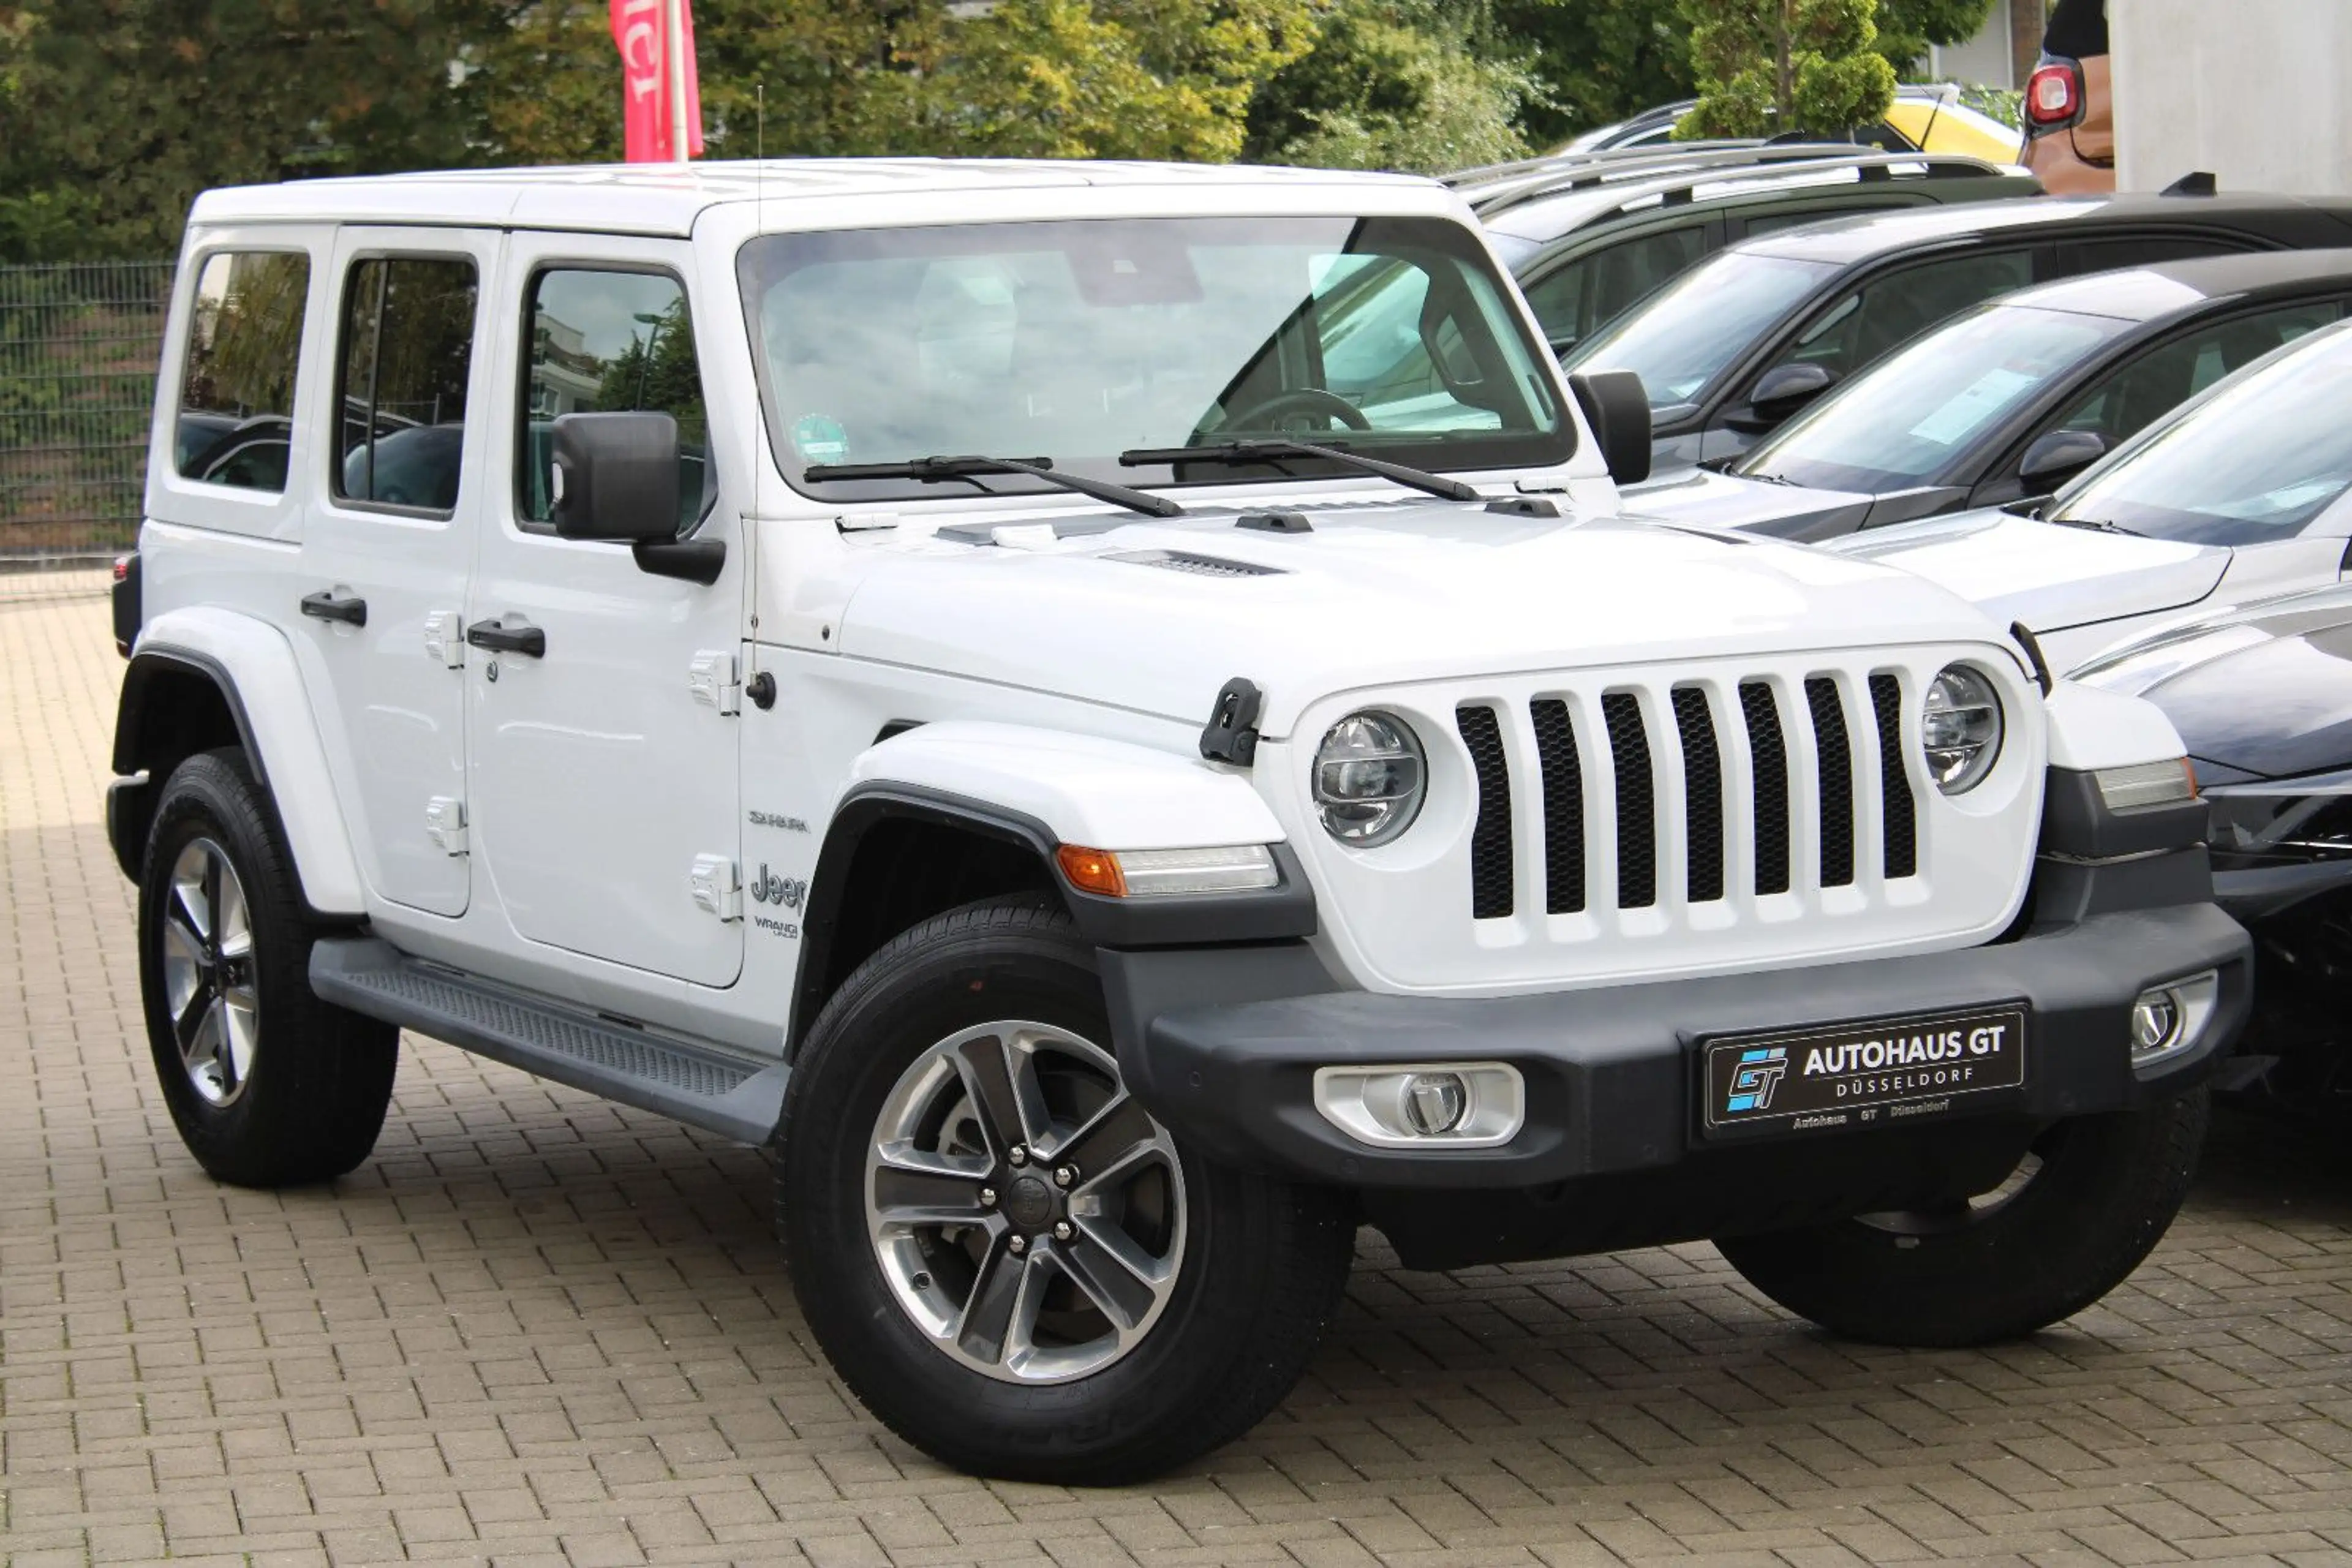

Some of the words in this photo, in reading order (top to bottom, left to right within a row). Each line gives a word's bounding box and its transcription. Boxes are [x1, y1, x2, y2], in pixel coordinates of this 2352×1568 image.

[1803, 1030, 1961, 1076] AUTOHAUS
[1969, 1025, 2005, 1055] GT
[1837, 1068, 1973, 1097] DÜSSELDORF
[1793, 1114, 1847, 1129] Autohaus
[1860, 1109, 1879, 1121] GT
[1890, 1099, 1950, 1118] Düsseldorf
